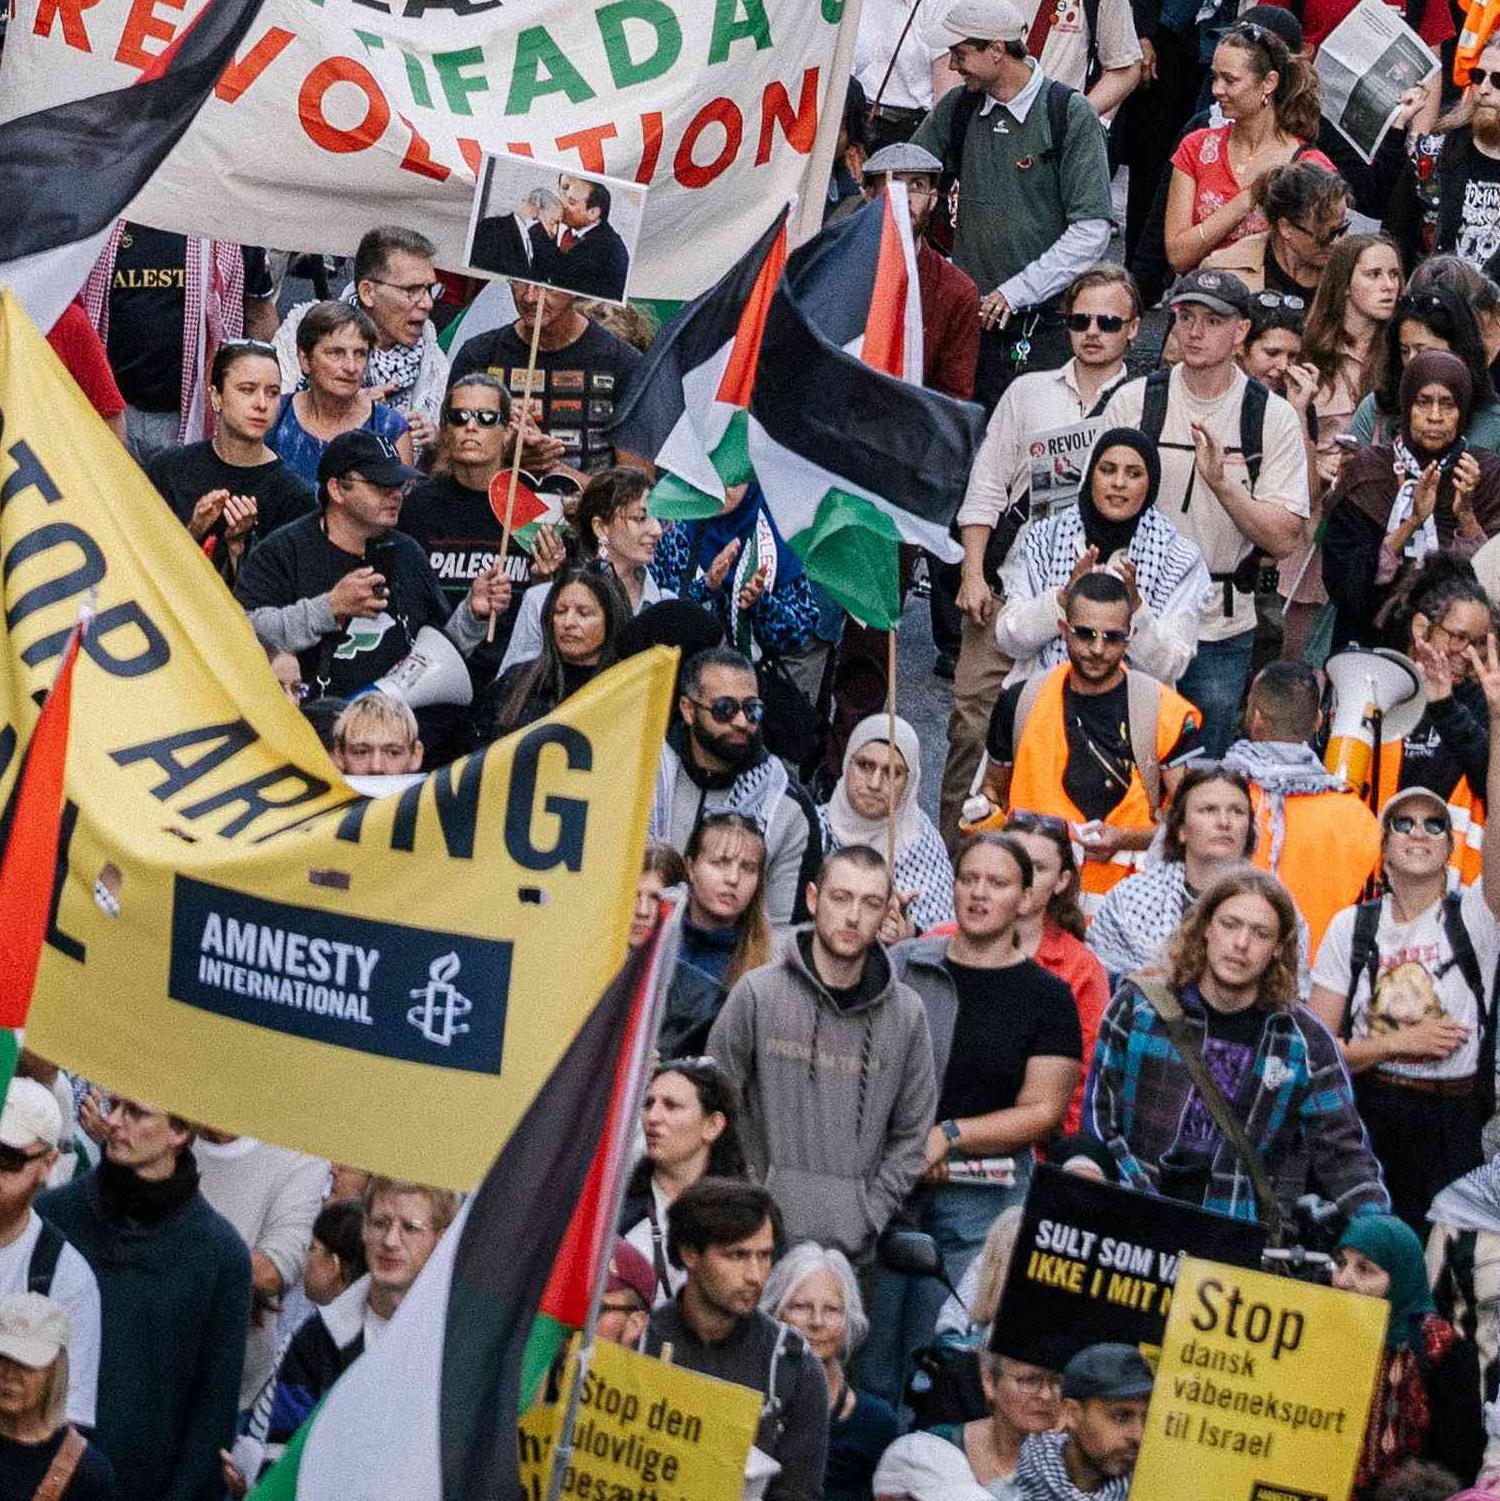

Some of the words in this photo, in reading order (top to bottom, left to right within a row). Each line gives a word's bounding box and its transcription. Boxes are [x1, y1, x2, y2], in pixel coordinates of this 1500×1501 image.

[200, 911, 381, 994] AMNESTY
[197, 960, 375, 1027] INTERNATIONAL
[1035, 1219, 1095, 1261] SULT
[1097, 1242, 1155, 1277] SOM
[1027, 1251, 1085, 1296] IKKE
[1089, 1271, 1104, 1298] I
[1106, 1274, 1159, 1317] MIT
[1192, 1277, 1307, 1358] Stop
[1179, 1338, 1258, 1380] dansk
[579, 1369, 639, 1427] Stop
[646, 1396, 703, 1444] den
[1163, 1409, 1195, 1440] til
[1197, 1415, 1275, 1461] Israel
[1173, 1373, 1348, 1436] våbeneksport
[571, 1425, 680, 1484] ulovlige
